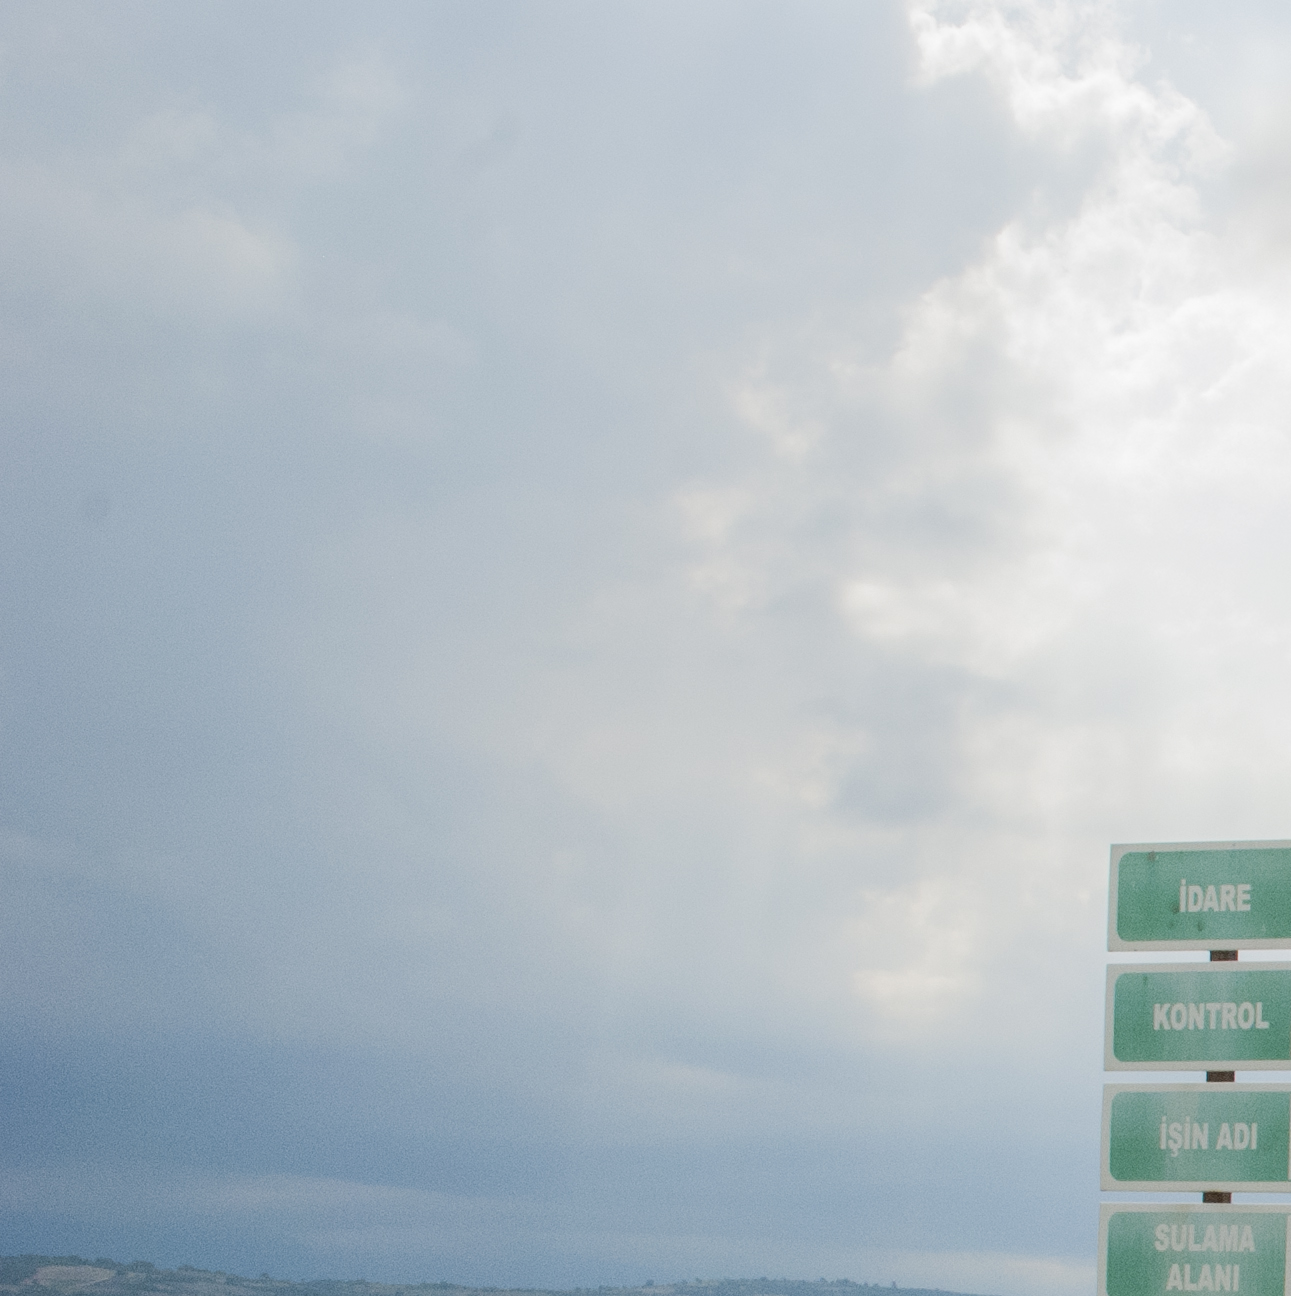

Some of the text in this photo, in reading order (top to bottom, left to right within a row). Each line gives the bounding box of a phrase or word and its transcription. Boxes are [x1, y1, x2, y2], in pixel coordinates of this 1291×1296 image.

[1179, 878, 1251, 914] İDARE
[1154, 1003, 1270, 1031] KONTROL
[1159, 1116, 1257, 1158] İŞİN ADI
[1155, 1224, 1255, 1253] SULAMA
[1166, 1263, 1239, 1292] ALANI
